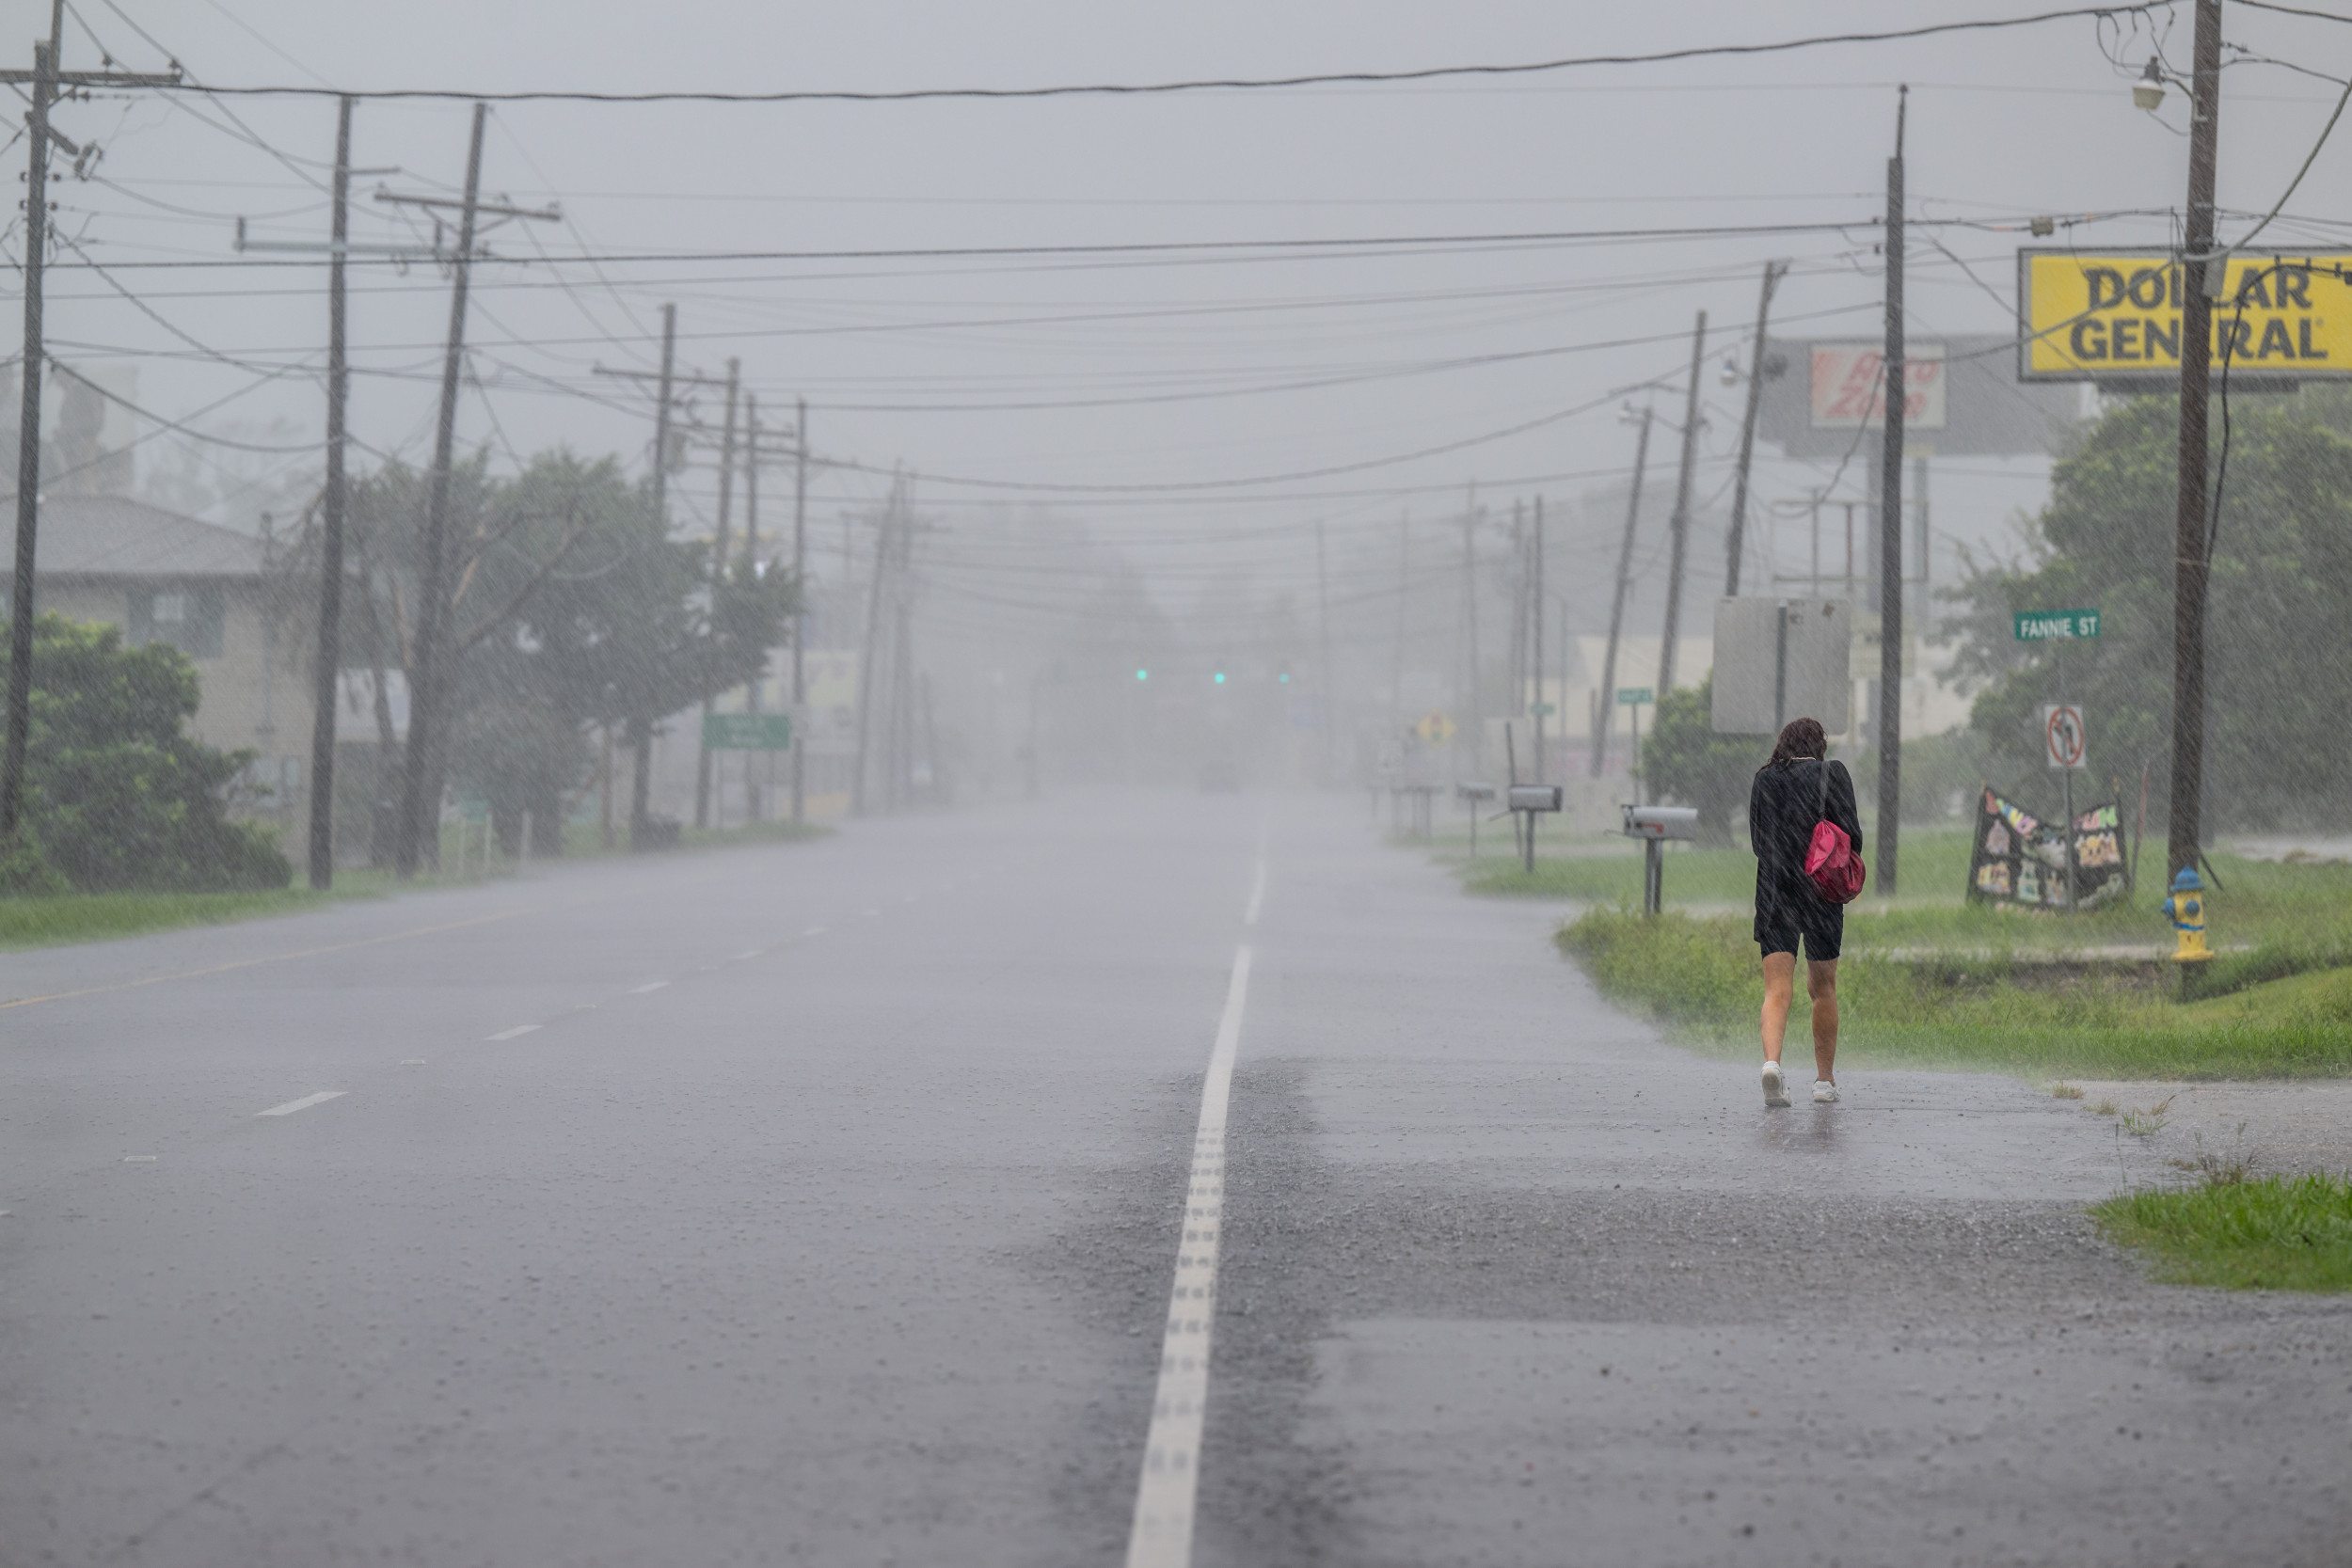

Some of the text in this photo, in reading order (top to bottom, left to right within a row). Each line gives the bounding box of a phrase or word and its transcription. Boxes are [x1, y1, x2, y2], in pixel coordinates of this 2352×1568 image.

[2086, 267, 2312, 309] DOLAR
[2071, 318, 2328, 360] GENRAL
[2021, 616, 2097, 638] FANNIE ST
